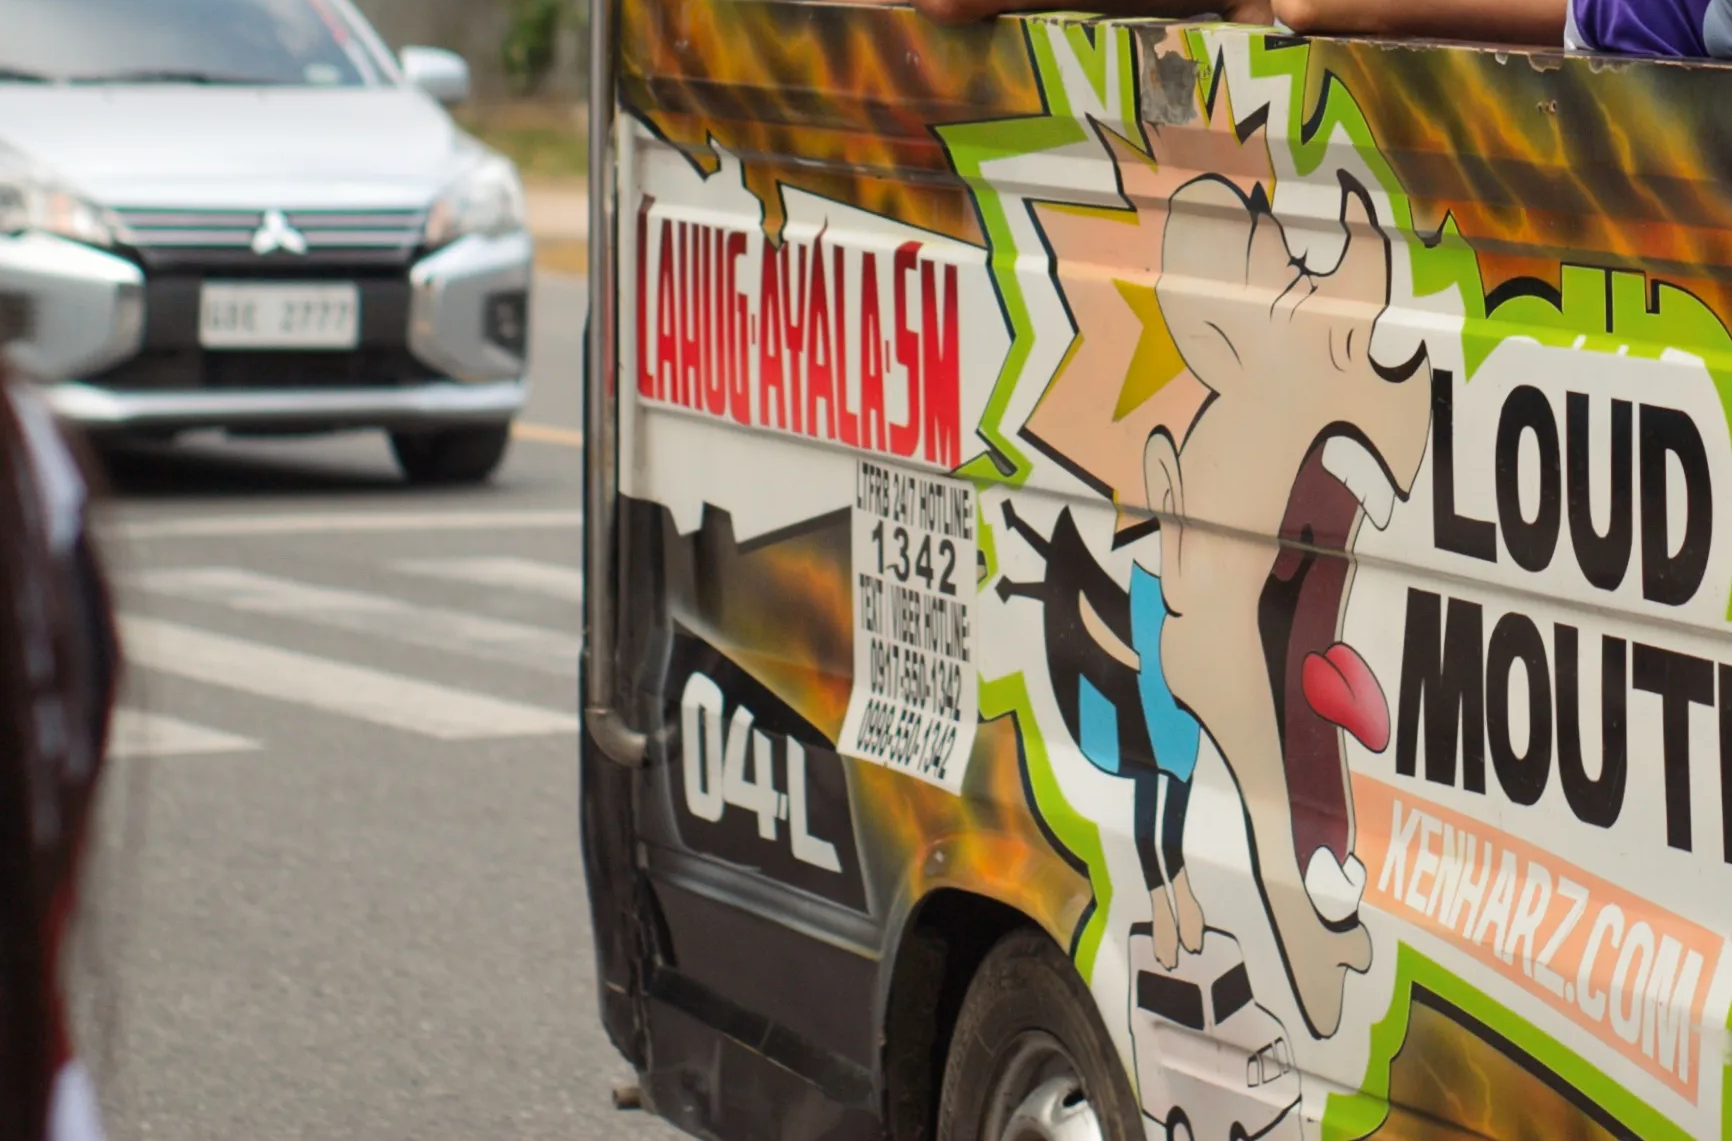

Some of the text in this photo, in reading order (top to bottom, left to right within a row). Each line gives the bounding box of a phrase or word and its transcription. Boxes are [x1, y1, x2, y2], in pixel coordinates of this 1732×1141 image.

[857, 458, 889, 518] LTFRB
[1431, 368, 1715, 608] LOUD
[872, 519, 956, 596] 1342
[859, 572, 883, 635] TEXT
[870, 637, 962, 723] 0917-550-1342
[1378, 800, 1704, 1081] KENHARZ.COM
